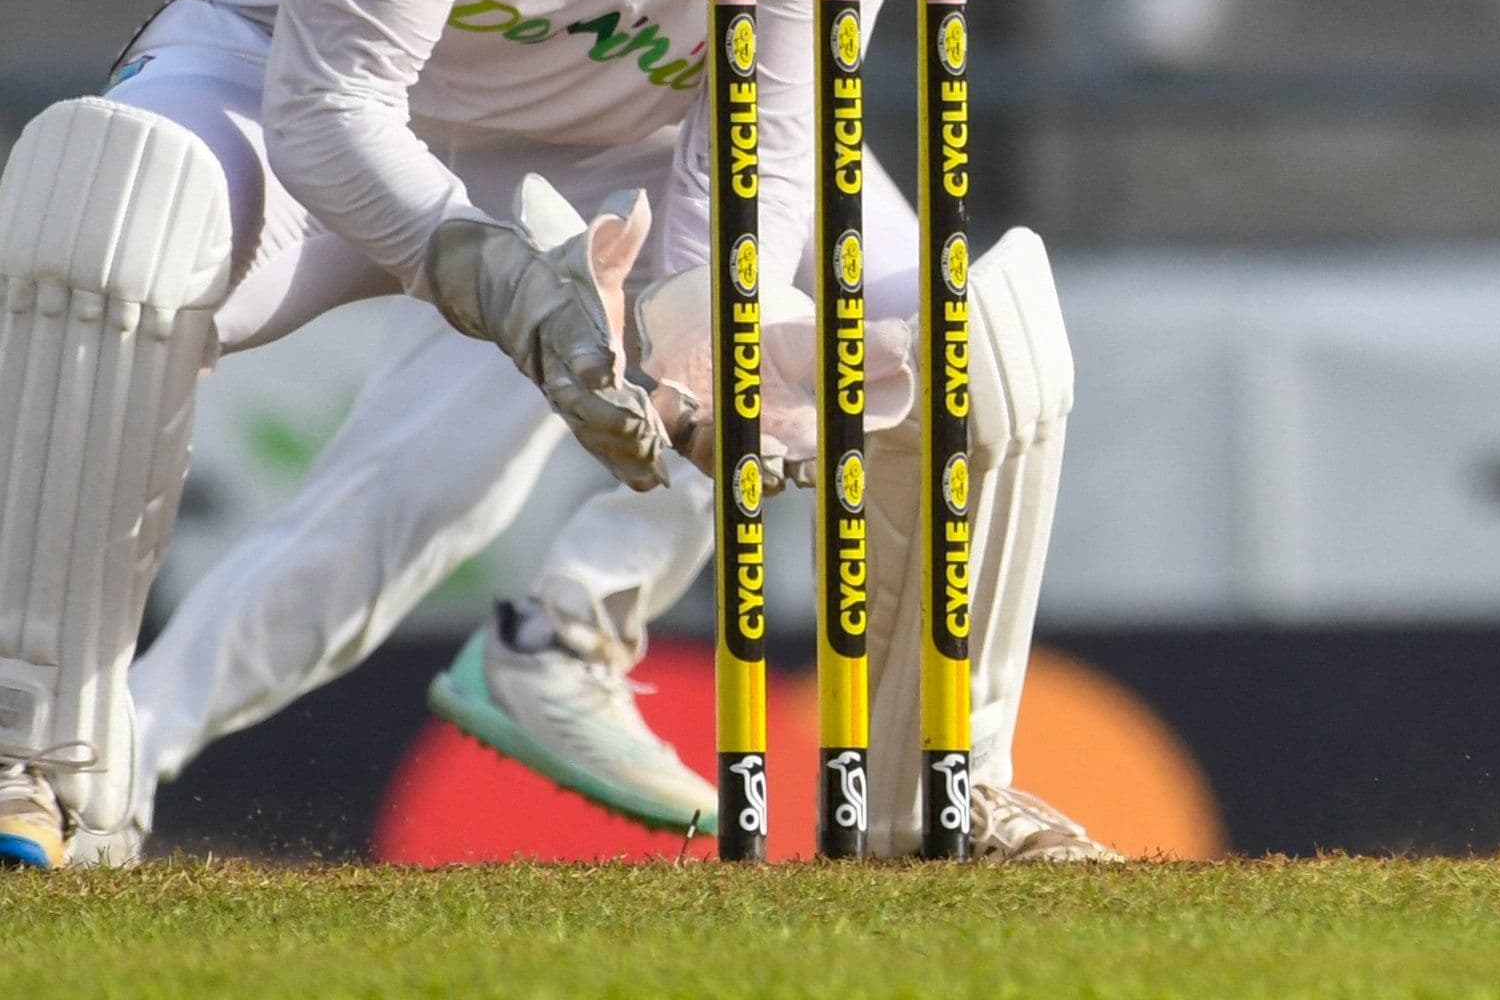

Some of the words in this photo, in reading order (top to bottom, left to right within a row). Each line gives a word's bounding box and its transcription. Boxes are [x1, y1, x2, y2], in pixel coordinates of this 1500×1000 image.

[730, 82, 758, 199] CYCLE
[834, 78, 863, 195] CYCLE
[942, 81, 969, 198] CYCLE
[733, 302, 761, 419] CYCLE
[837, 298, 865, 415] CYCLE
[945, 301, 971, 418] CYCLE
[737, 523, 765, 640] CYCLE
[839, 518, 868, 636] CYCLE
[945, 521, 972, 638] CYCLE
